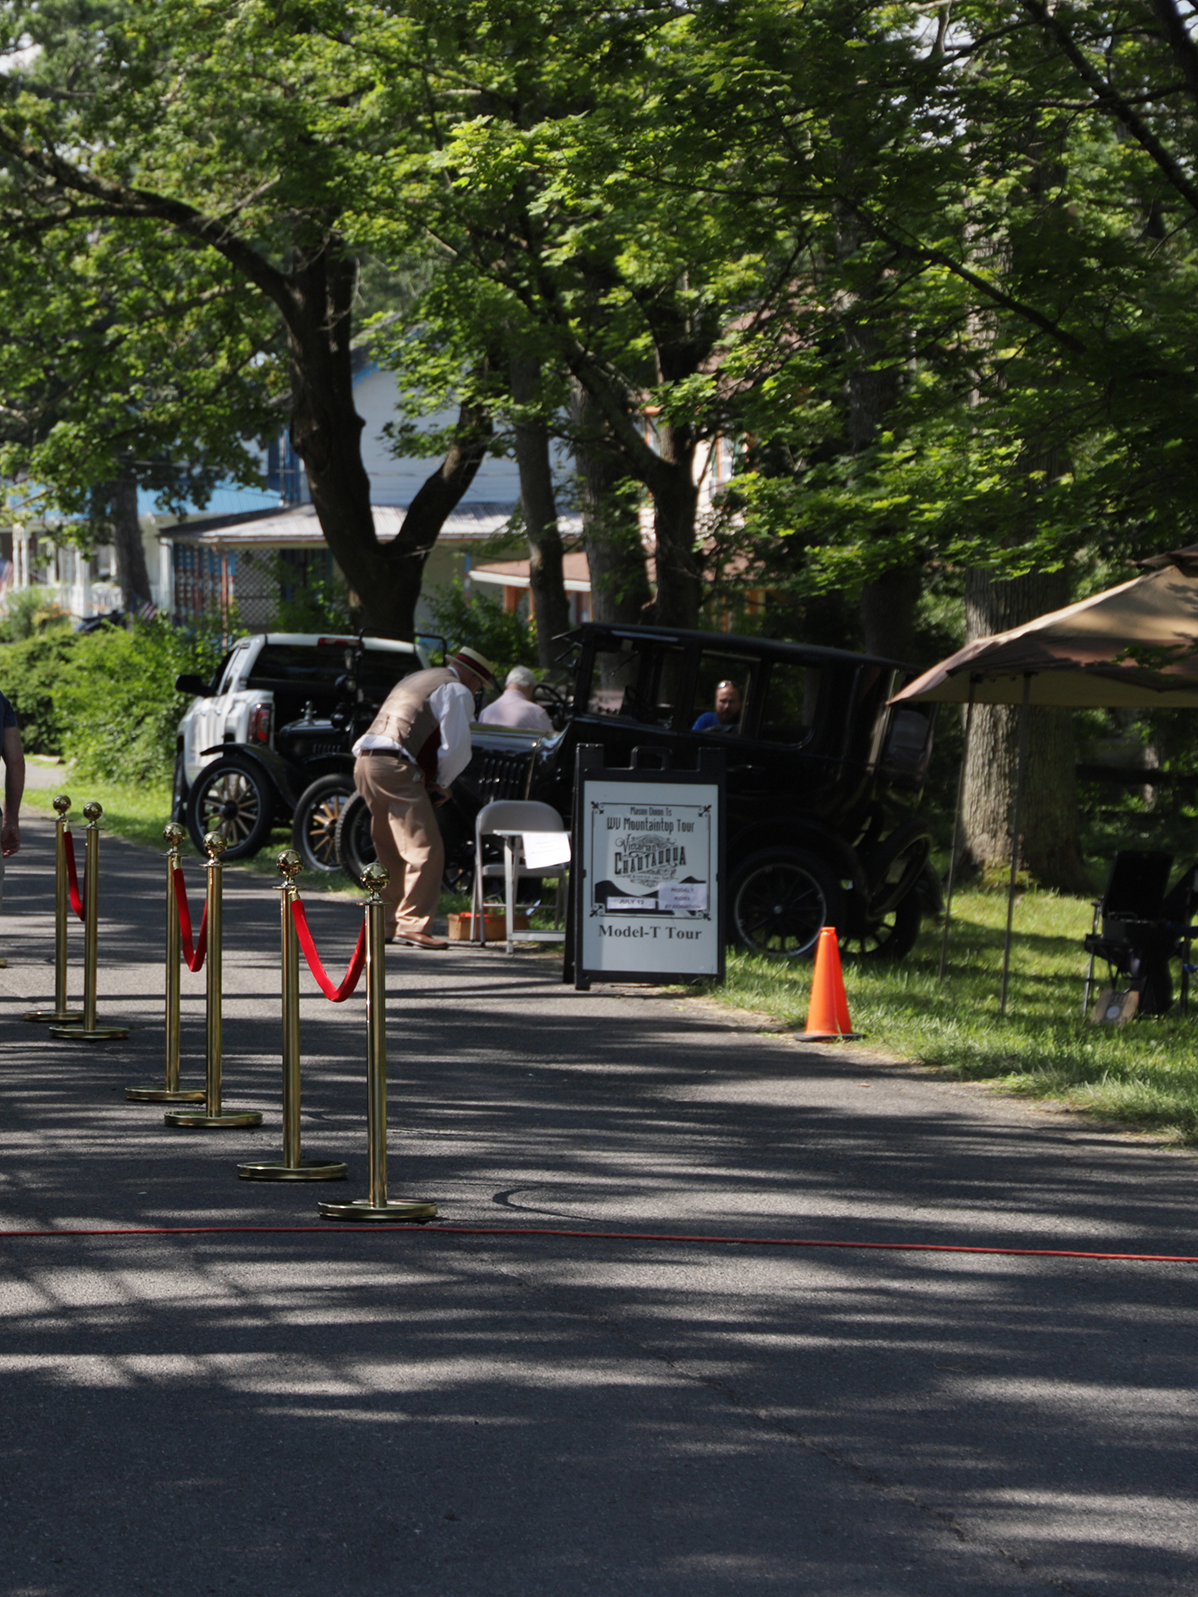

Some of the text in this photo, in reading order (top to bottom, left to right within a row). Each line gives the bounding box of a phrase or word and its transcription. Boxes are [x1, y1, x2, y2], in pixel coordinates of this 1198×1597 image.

[606, 817, 695, 835] WV Mountaintop Tour
[614, 833, 657, 853] Victorian
[614, 846, 687, 875] CHAUTAUQUA
[598, 925, 702, 940] Model-T Tour
